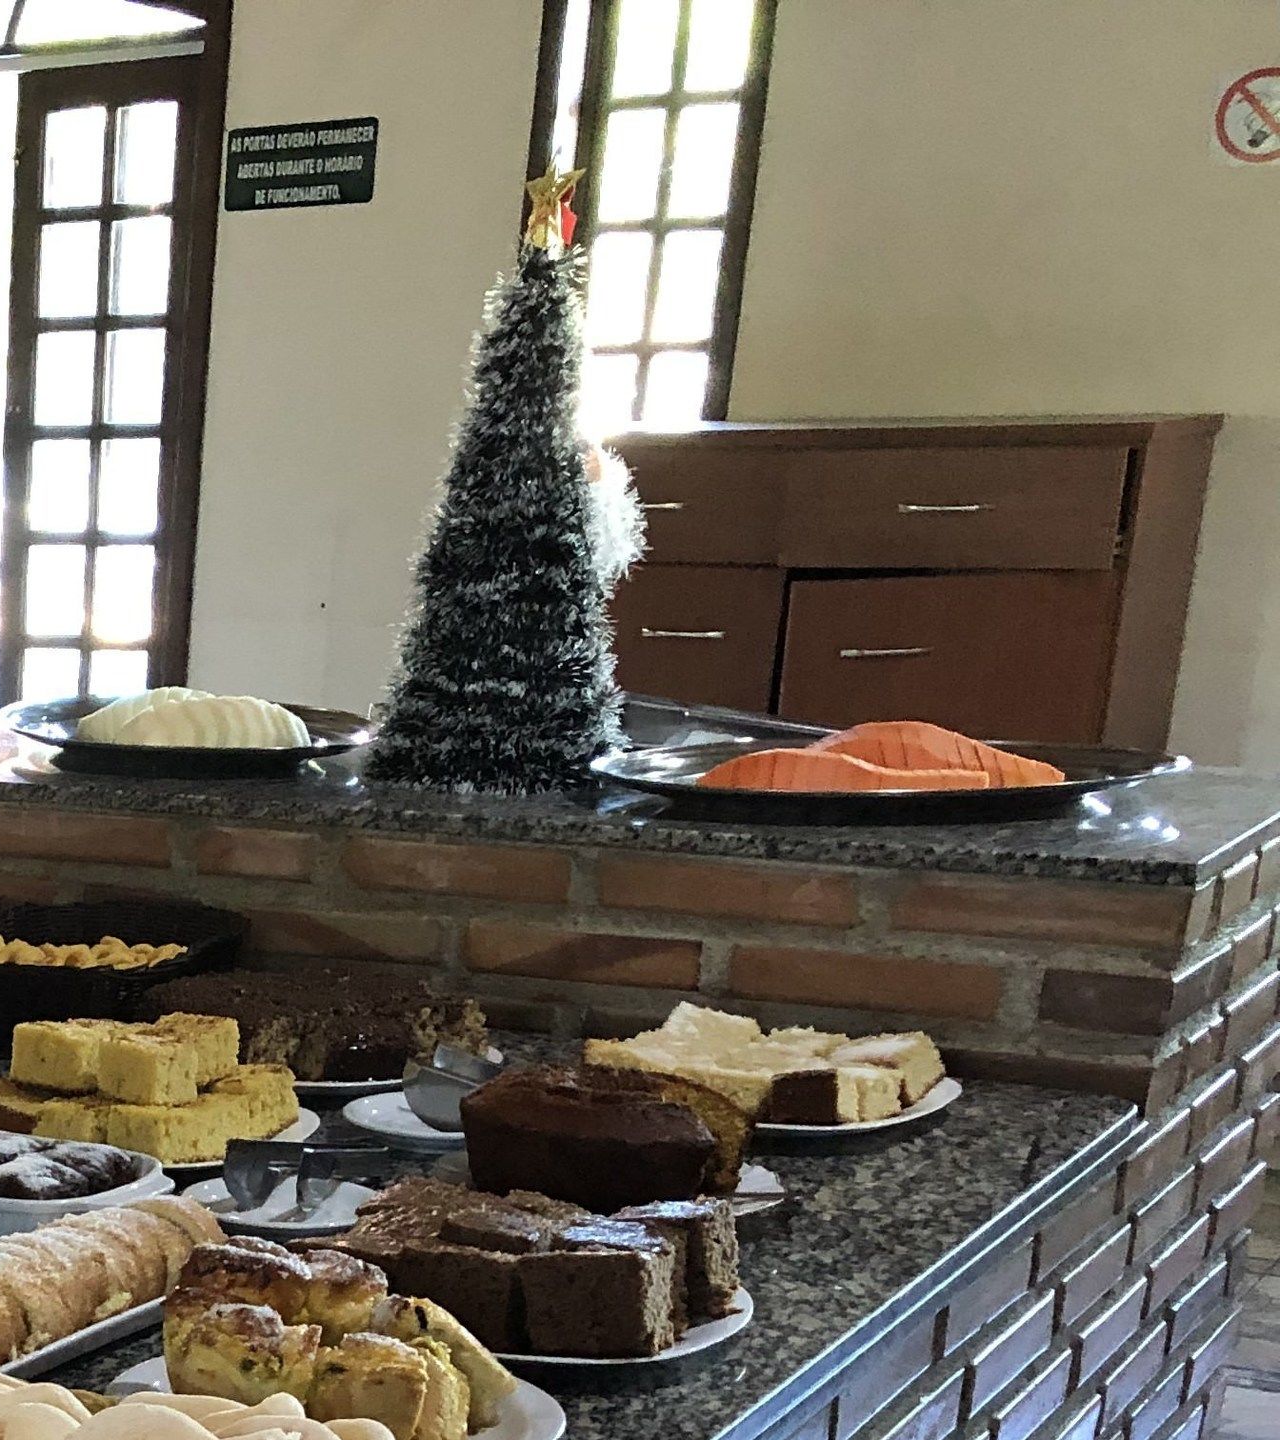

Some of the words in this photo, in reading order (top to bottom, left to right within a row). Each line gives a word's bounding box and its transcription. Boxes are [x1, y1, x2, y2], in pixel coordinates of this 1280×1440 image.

[231, 136, 241, 152] AS
[243, 134, 275, 151] PORTAS
[317, 125, 374, 146] PERMANECER
[276, 158, 315, 176] DURANTE
[316, 159, 324, 173] O
[255, 189, 266, 205] DE
